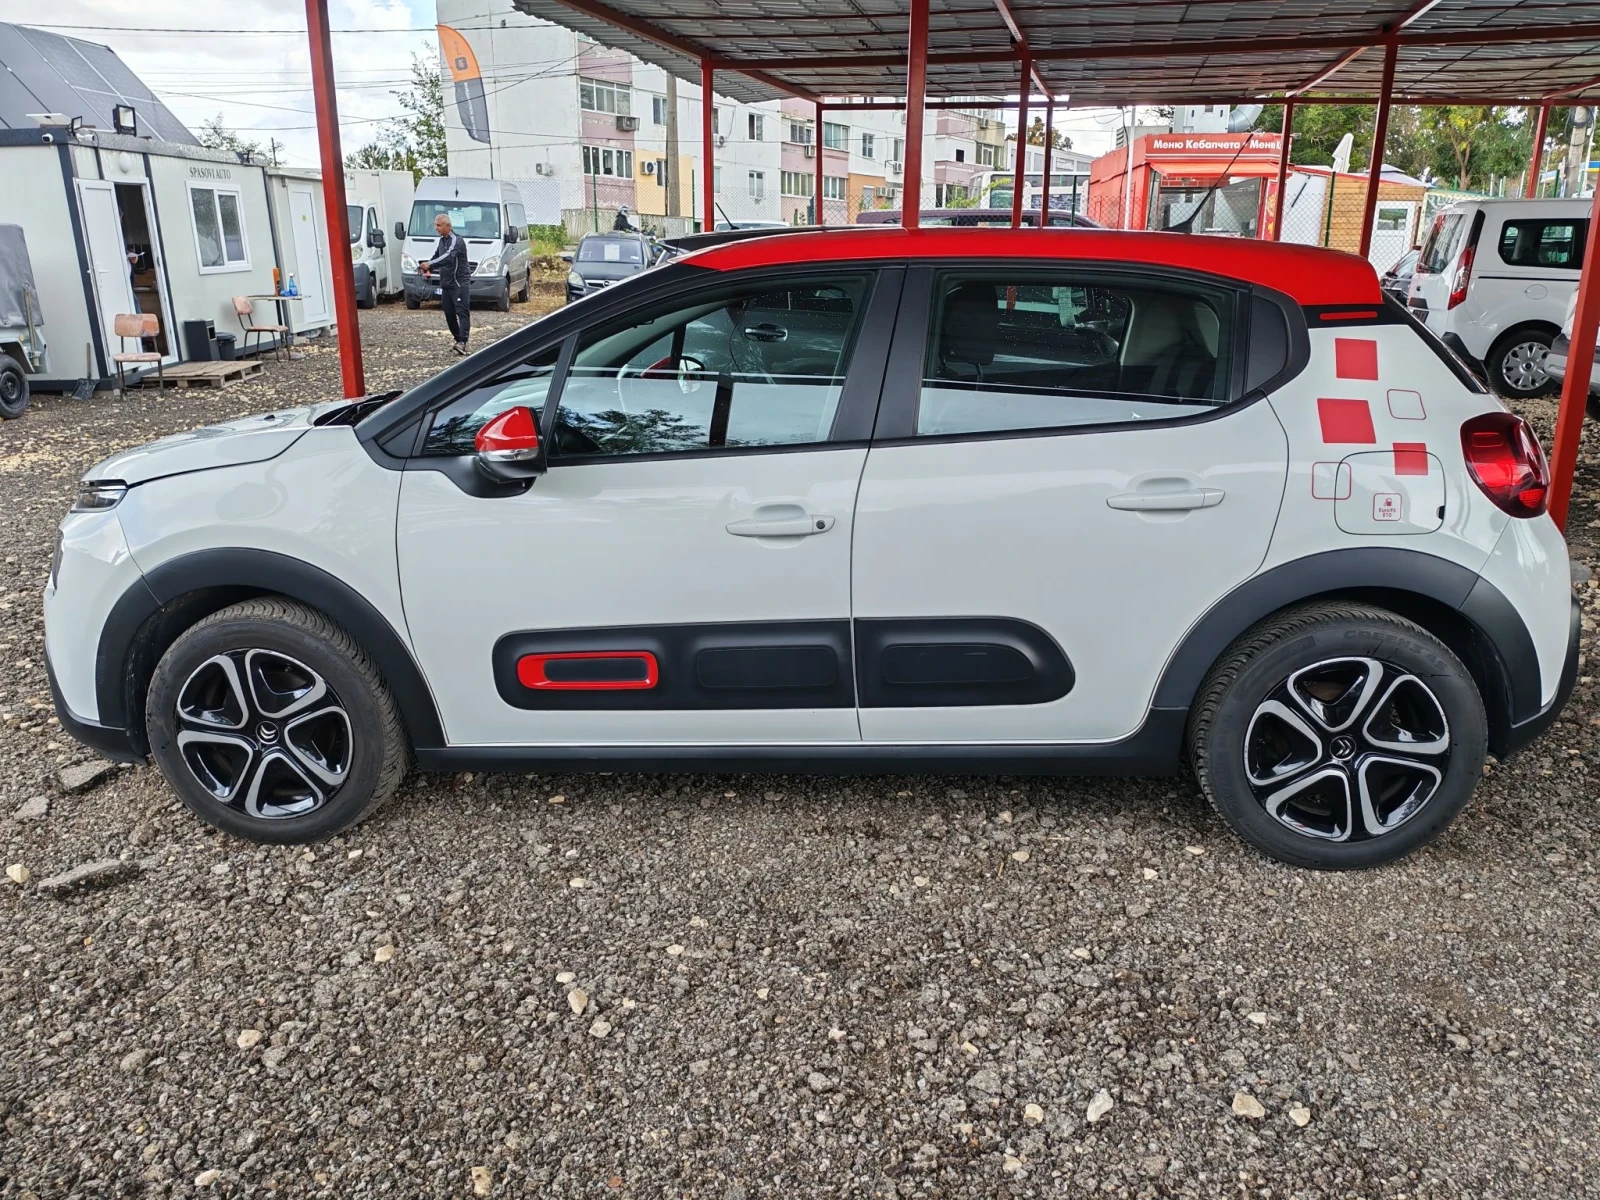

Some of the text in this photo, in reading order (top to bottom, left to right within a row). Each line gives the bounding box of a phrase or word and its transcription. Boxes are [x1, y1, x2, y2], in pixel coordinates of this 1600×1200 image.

[1153, 139, 1183, 150] Меню
[1185, 139, 1241, 150] Кебапчета
[189, 166, 232, 180] SPASOVI AUTO
